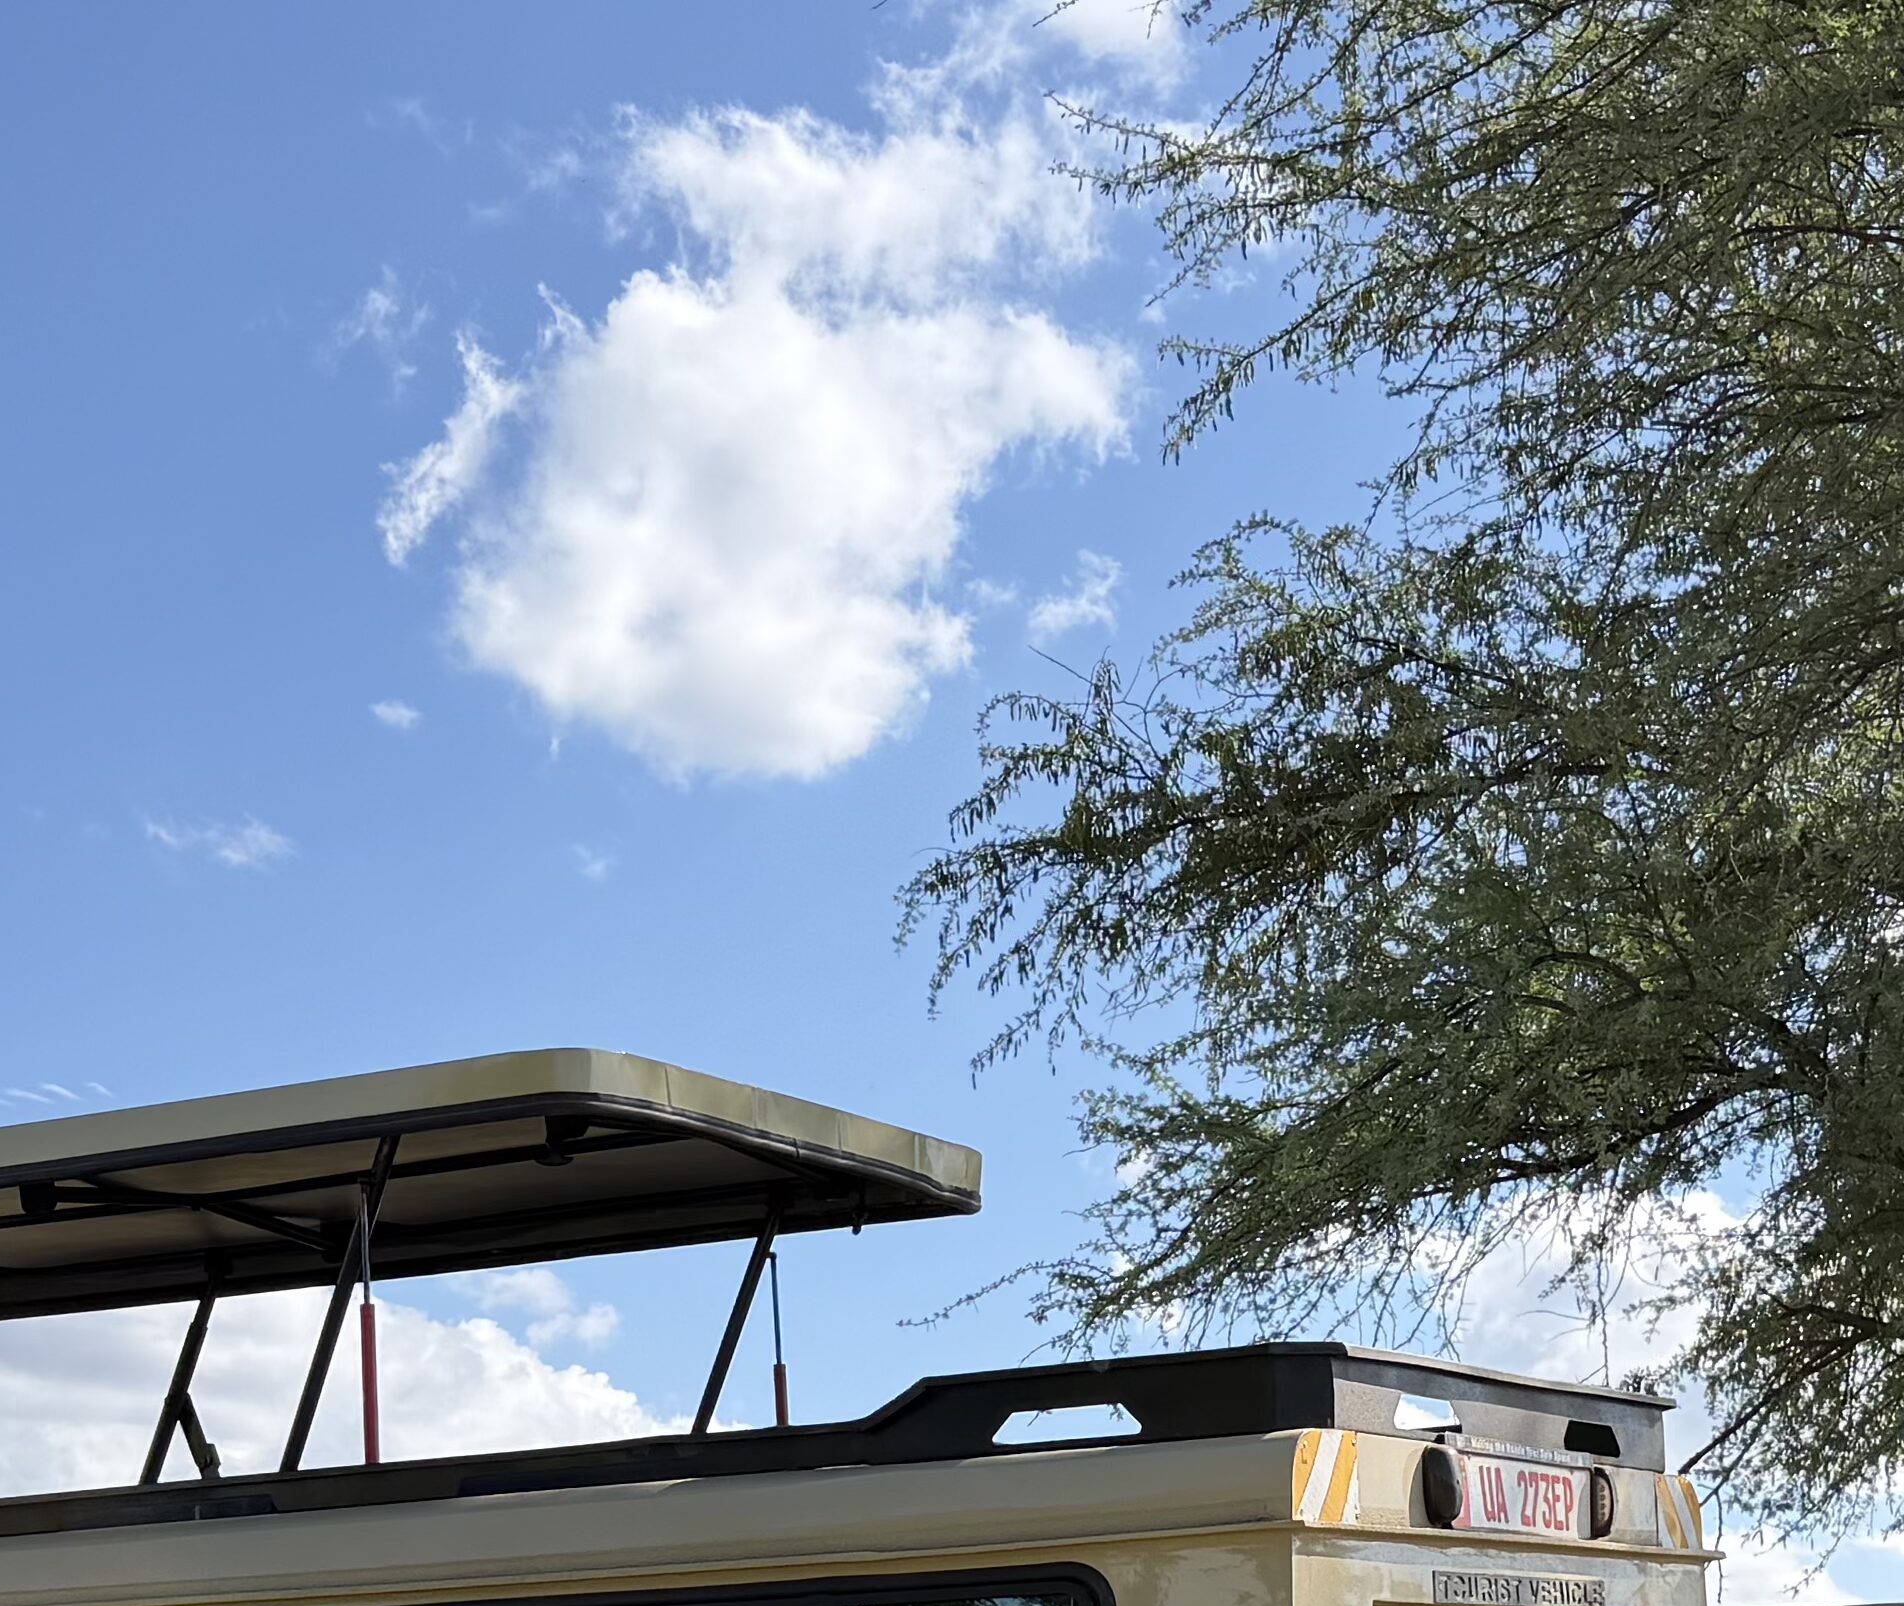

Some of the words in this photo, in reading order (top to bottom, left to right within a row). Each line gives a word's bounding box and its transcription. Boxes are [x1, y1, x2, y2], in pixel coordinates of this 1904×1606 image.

[1478, 1464, 1510, 1524] UA
[1516, 1469, 1574, 1532] 273EP
[1439, 1575, 1522, 1603] TOURIST
